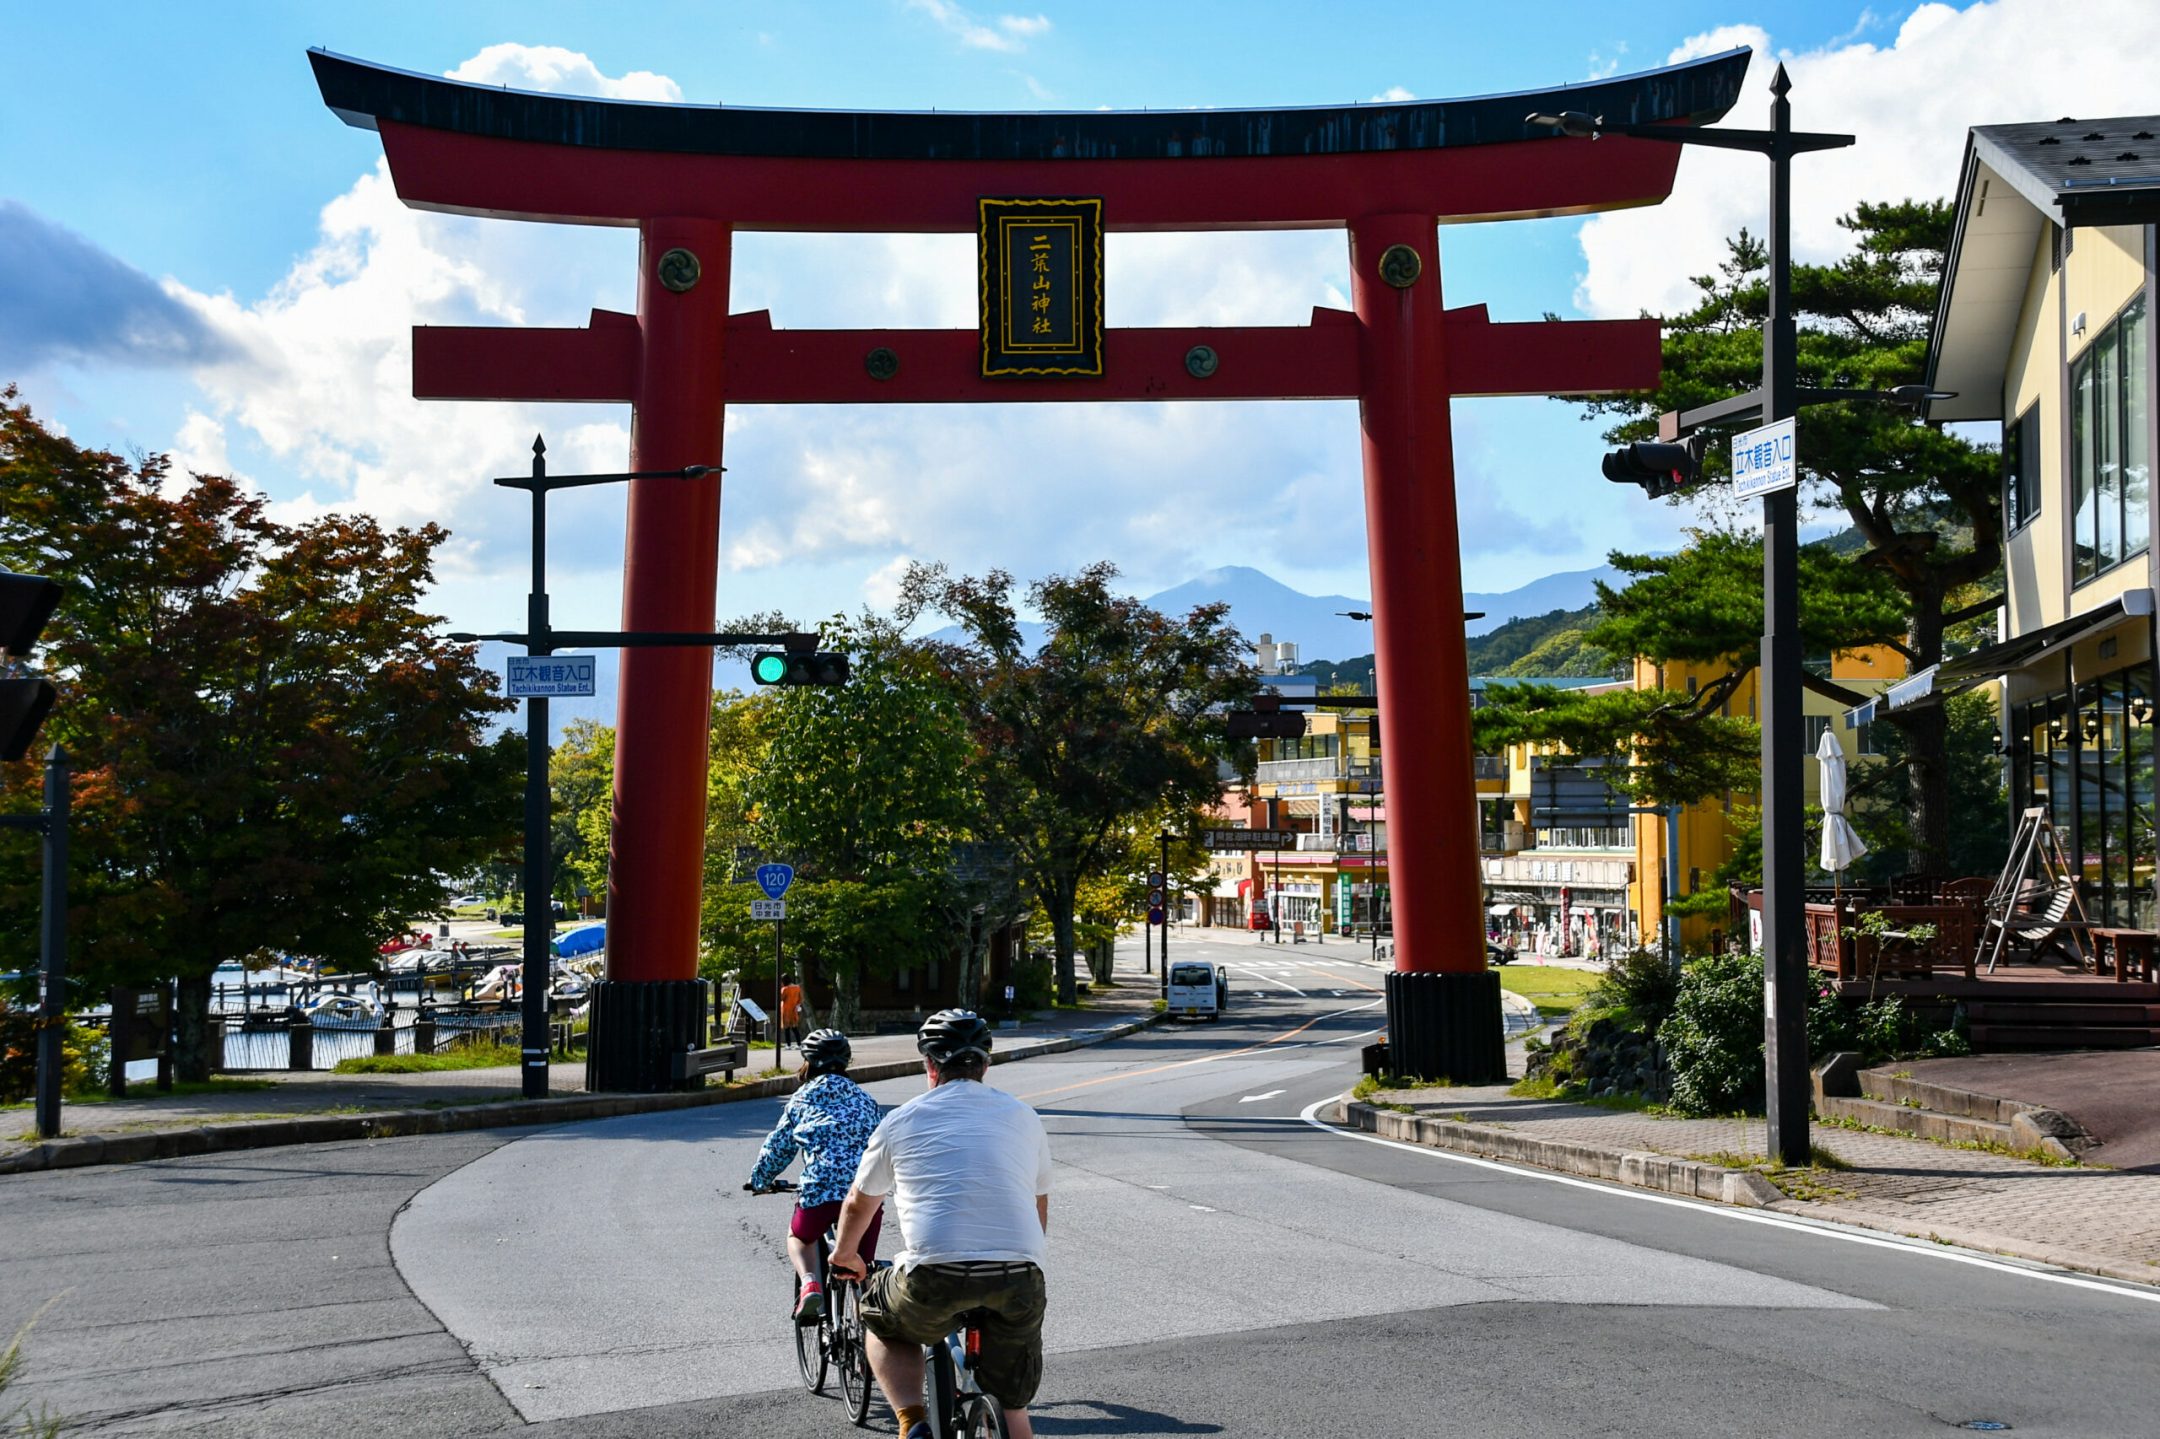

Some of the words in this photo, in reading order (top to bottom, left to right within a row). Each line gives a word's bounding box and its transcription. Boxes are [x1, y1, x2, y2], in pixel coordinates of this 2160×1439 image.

[1029, 235, 1052, 334] 二荒山神社
[1736, 435, 1791, 475] 立木観音入口
[512, 664, 591, 682] 立木観音入口
[512, 684, 555, 693] Tachikikannon
[557, 683, 577, 692] Statue
[764, 872, 786, 886] 120
[755, 901, 781, 910] 日光市
